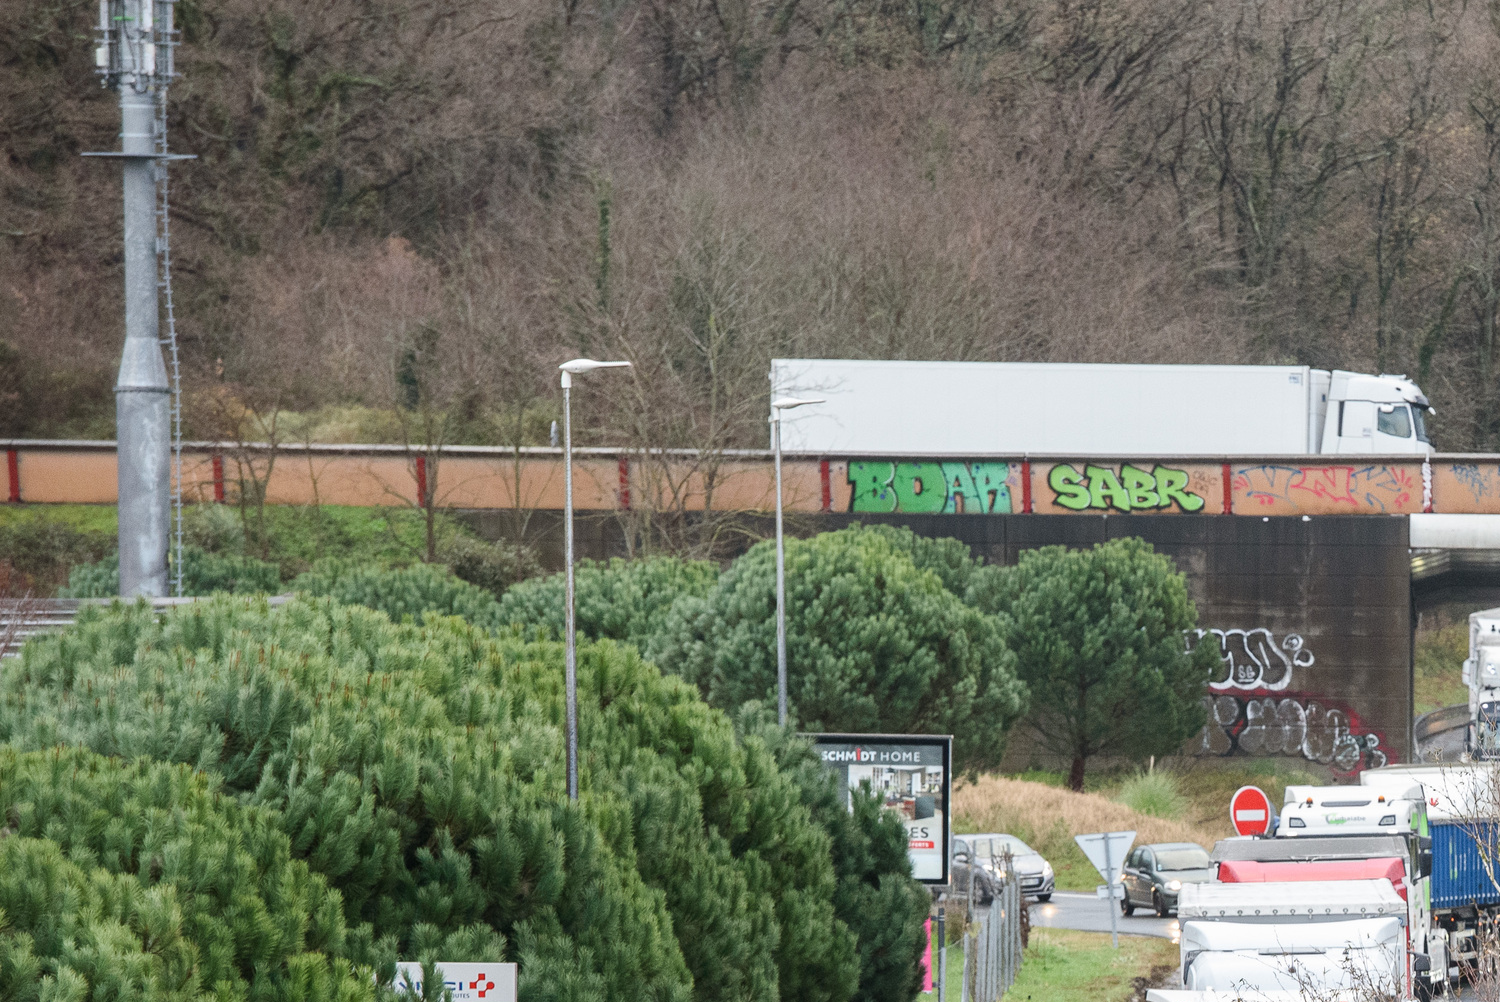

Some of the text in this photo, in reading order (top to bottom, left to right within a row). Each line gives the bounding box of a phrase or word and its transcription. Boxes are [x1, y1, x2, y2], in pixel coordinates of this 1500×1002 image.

[1048, 463, 1206, 513] SABR
[821, 748, 921, 763] SCHMIDT HOME
[908, 827, 929, 839] ES
